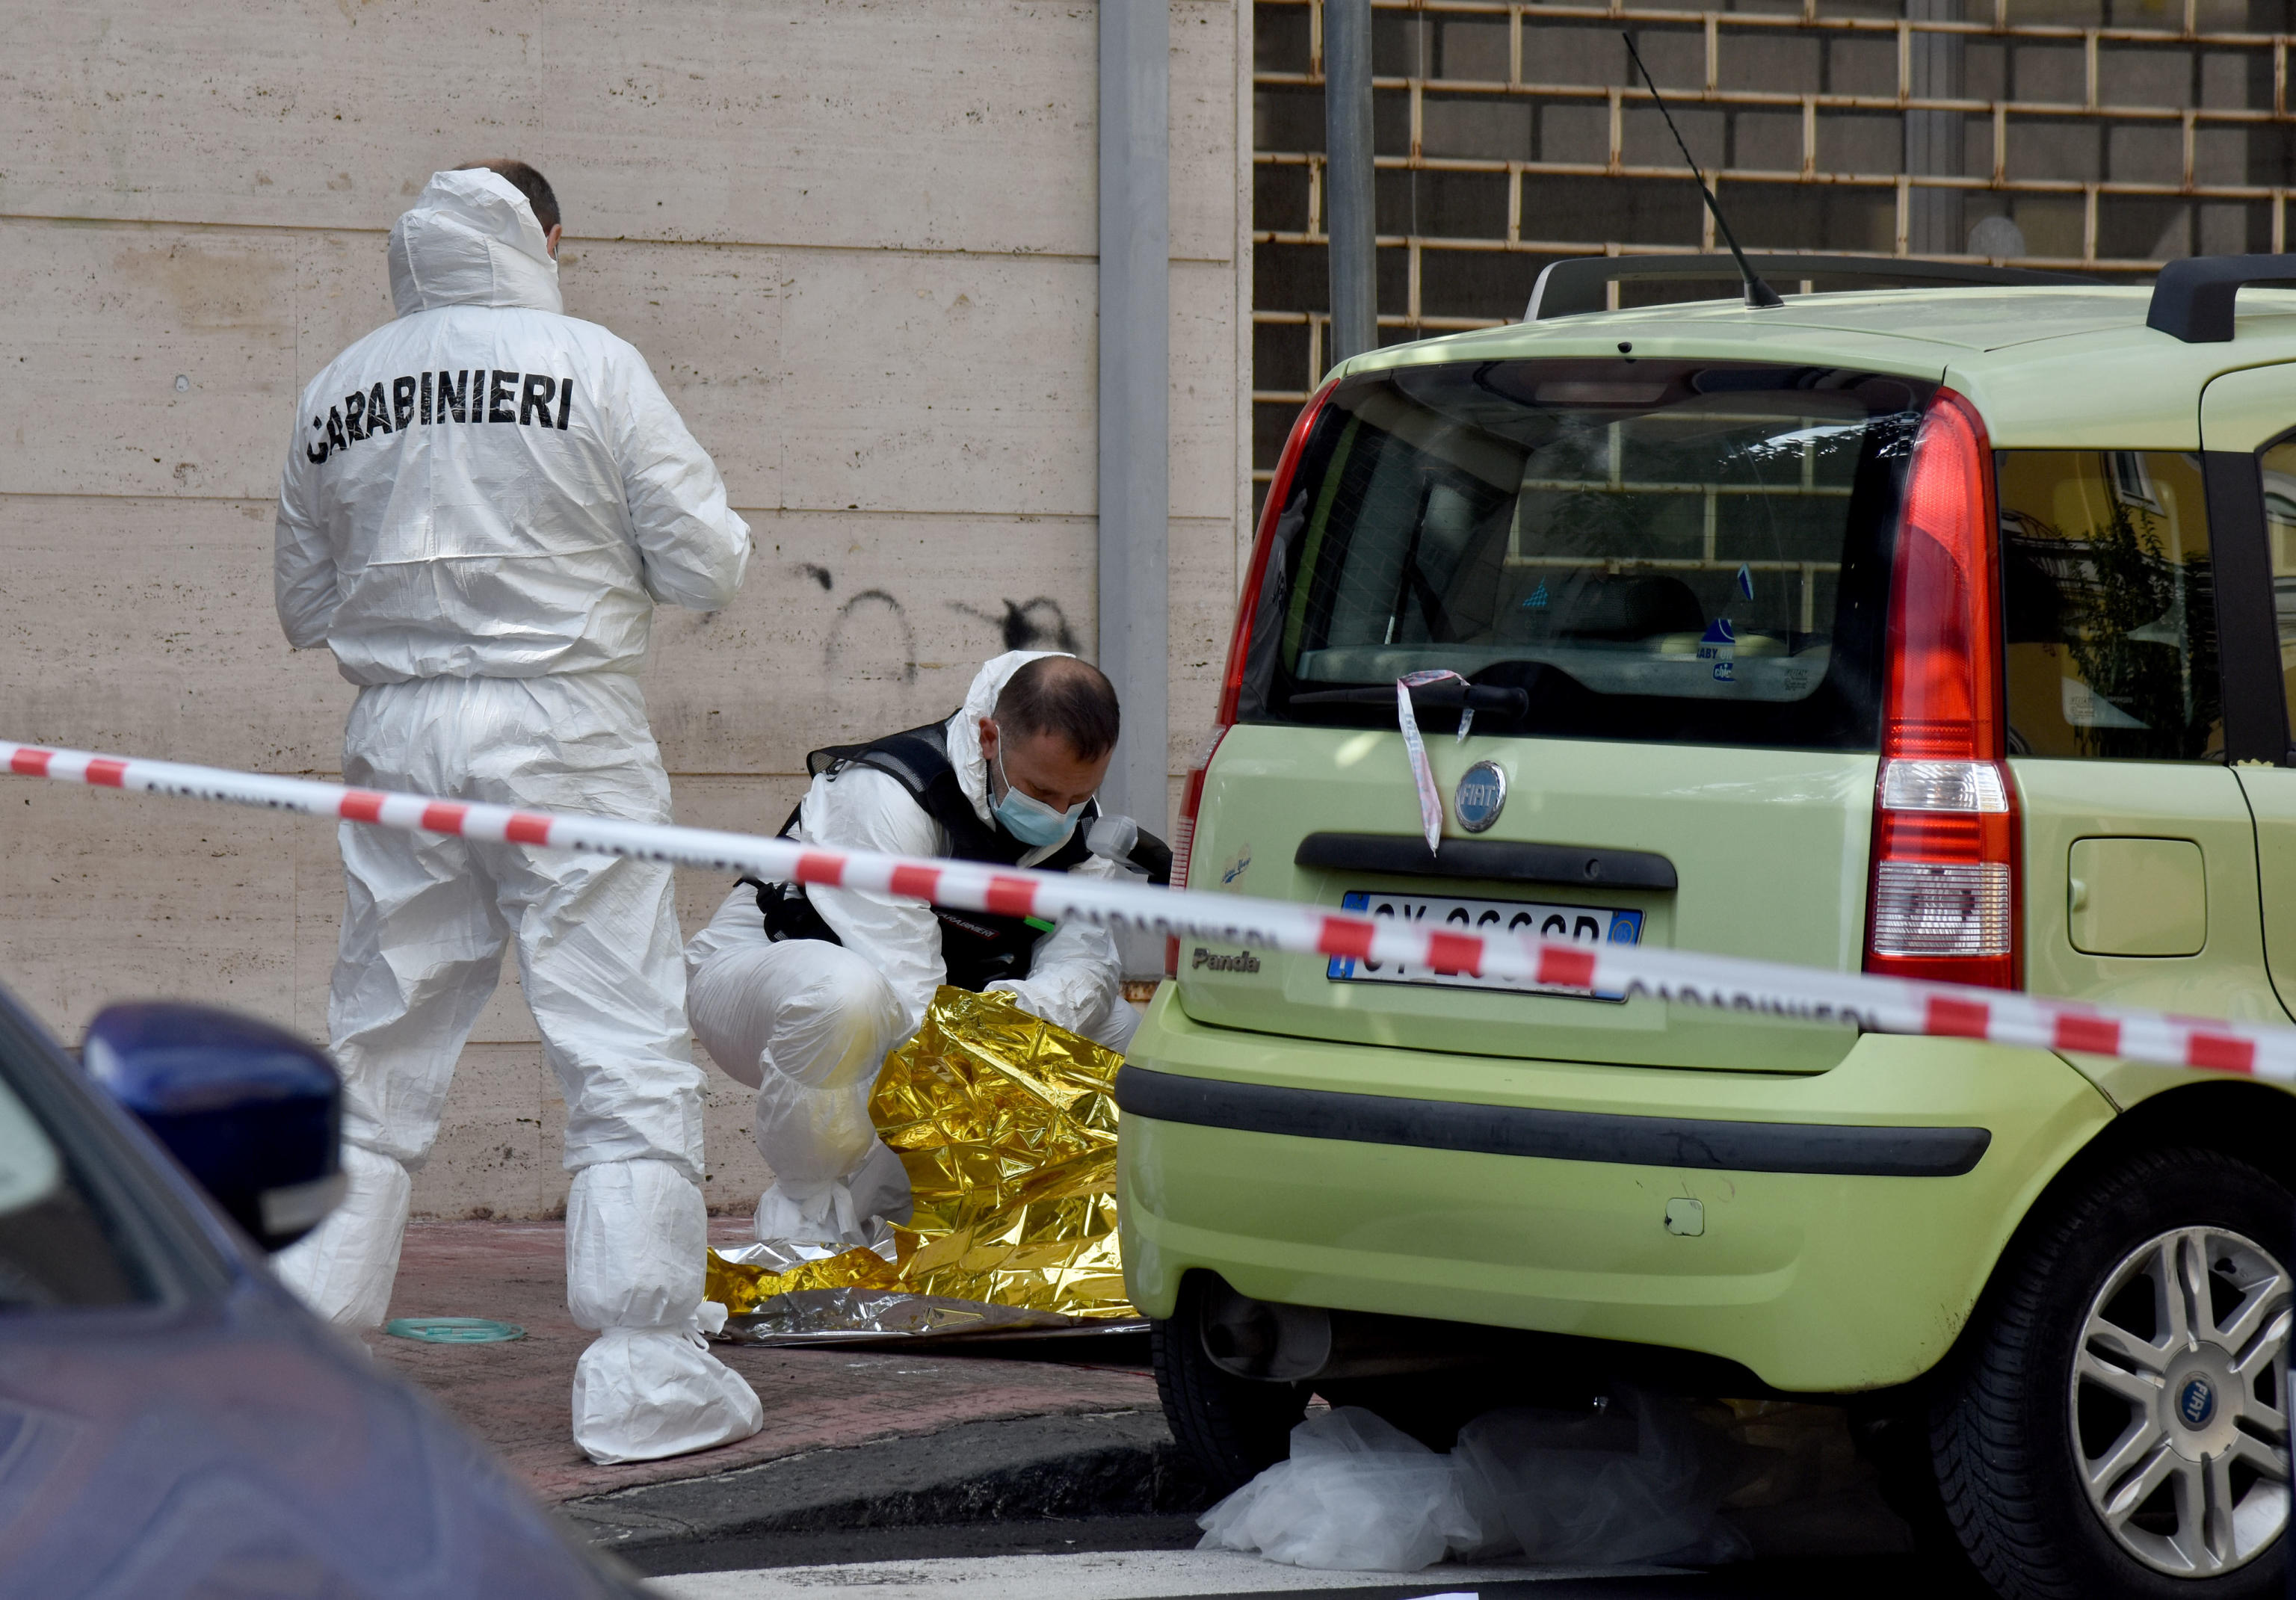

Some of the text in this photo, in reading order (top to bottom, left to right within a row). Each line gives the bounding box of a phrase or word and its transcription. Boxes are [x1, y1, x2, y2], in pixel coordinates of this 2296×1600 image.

[306, 369, 573, 465] CARABINIERI
[1696, 647, 1718, 659] ABY
[1460, 783, 1496, 806] FIAT
[1191, 947, 1261, 974] Panda
[2187, 1381, 2209, 1421] FIAT
